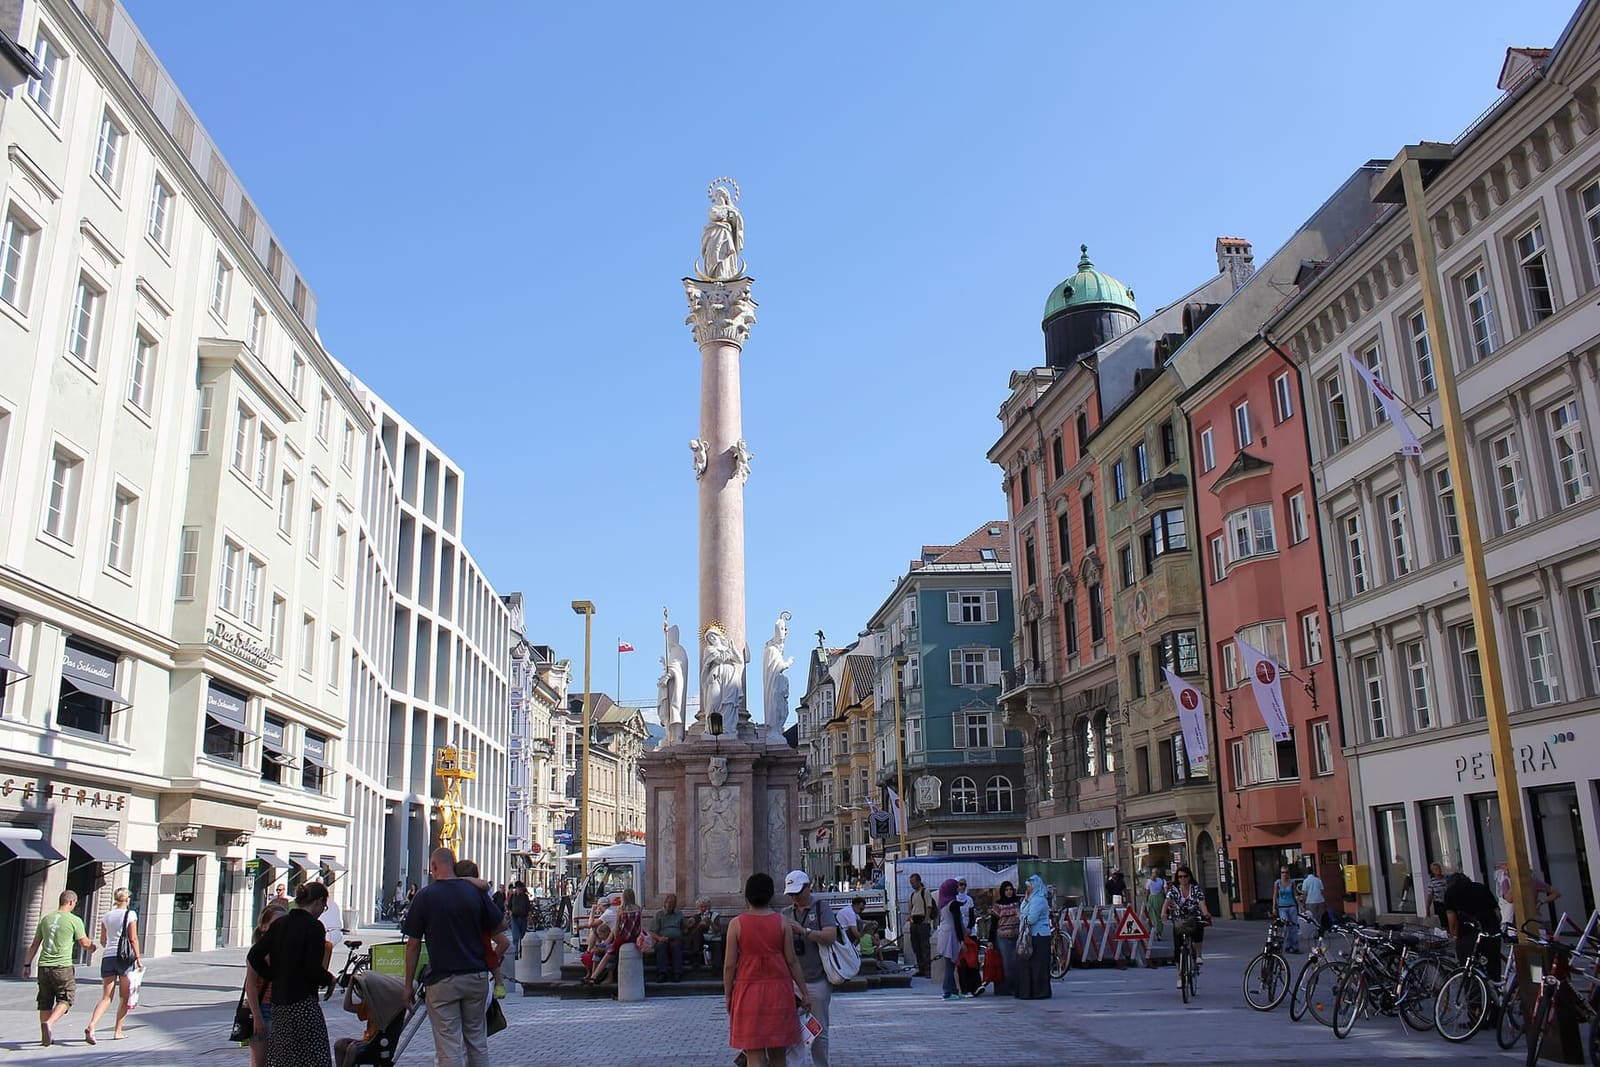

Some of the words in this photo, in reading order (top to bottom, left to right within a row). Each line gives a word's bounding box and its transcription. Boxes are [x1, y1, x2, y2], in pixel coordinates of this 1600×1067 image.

[215, 621, 234, 643] Das
[63, 655, 76, 668] Das
[77, 660, 111, 679] Schindler
[957, 844, 1013, 852] intimissimi
